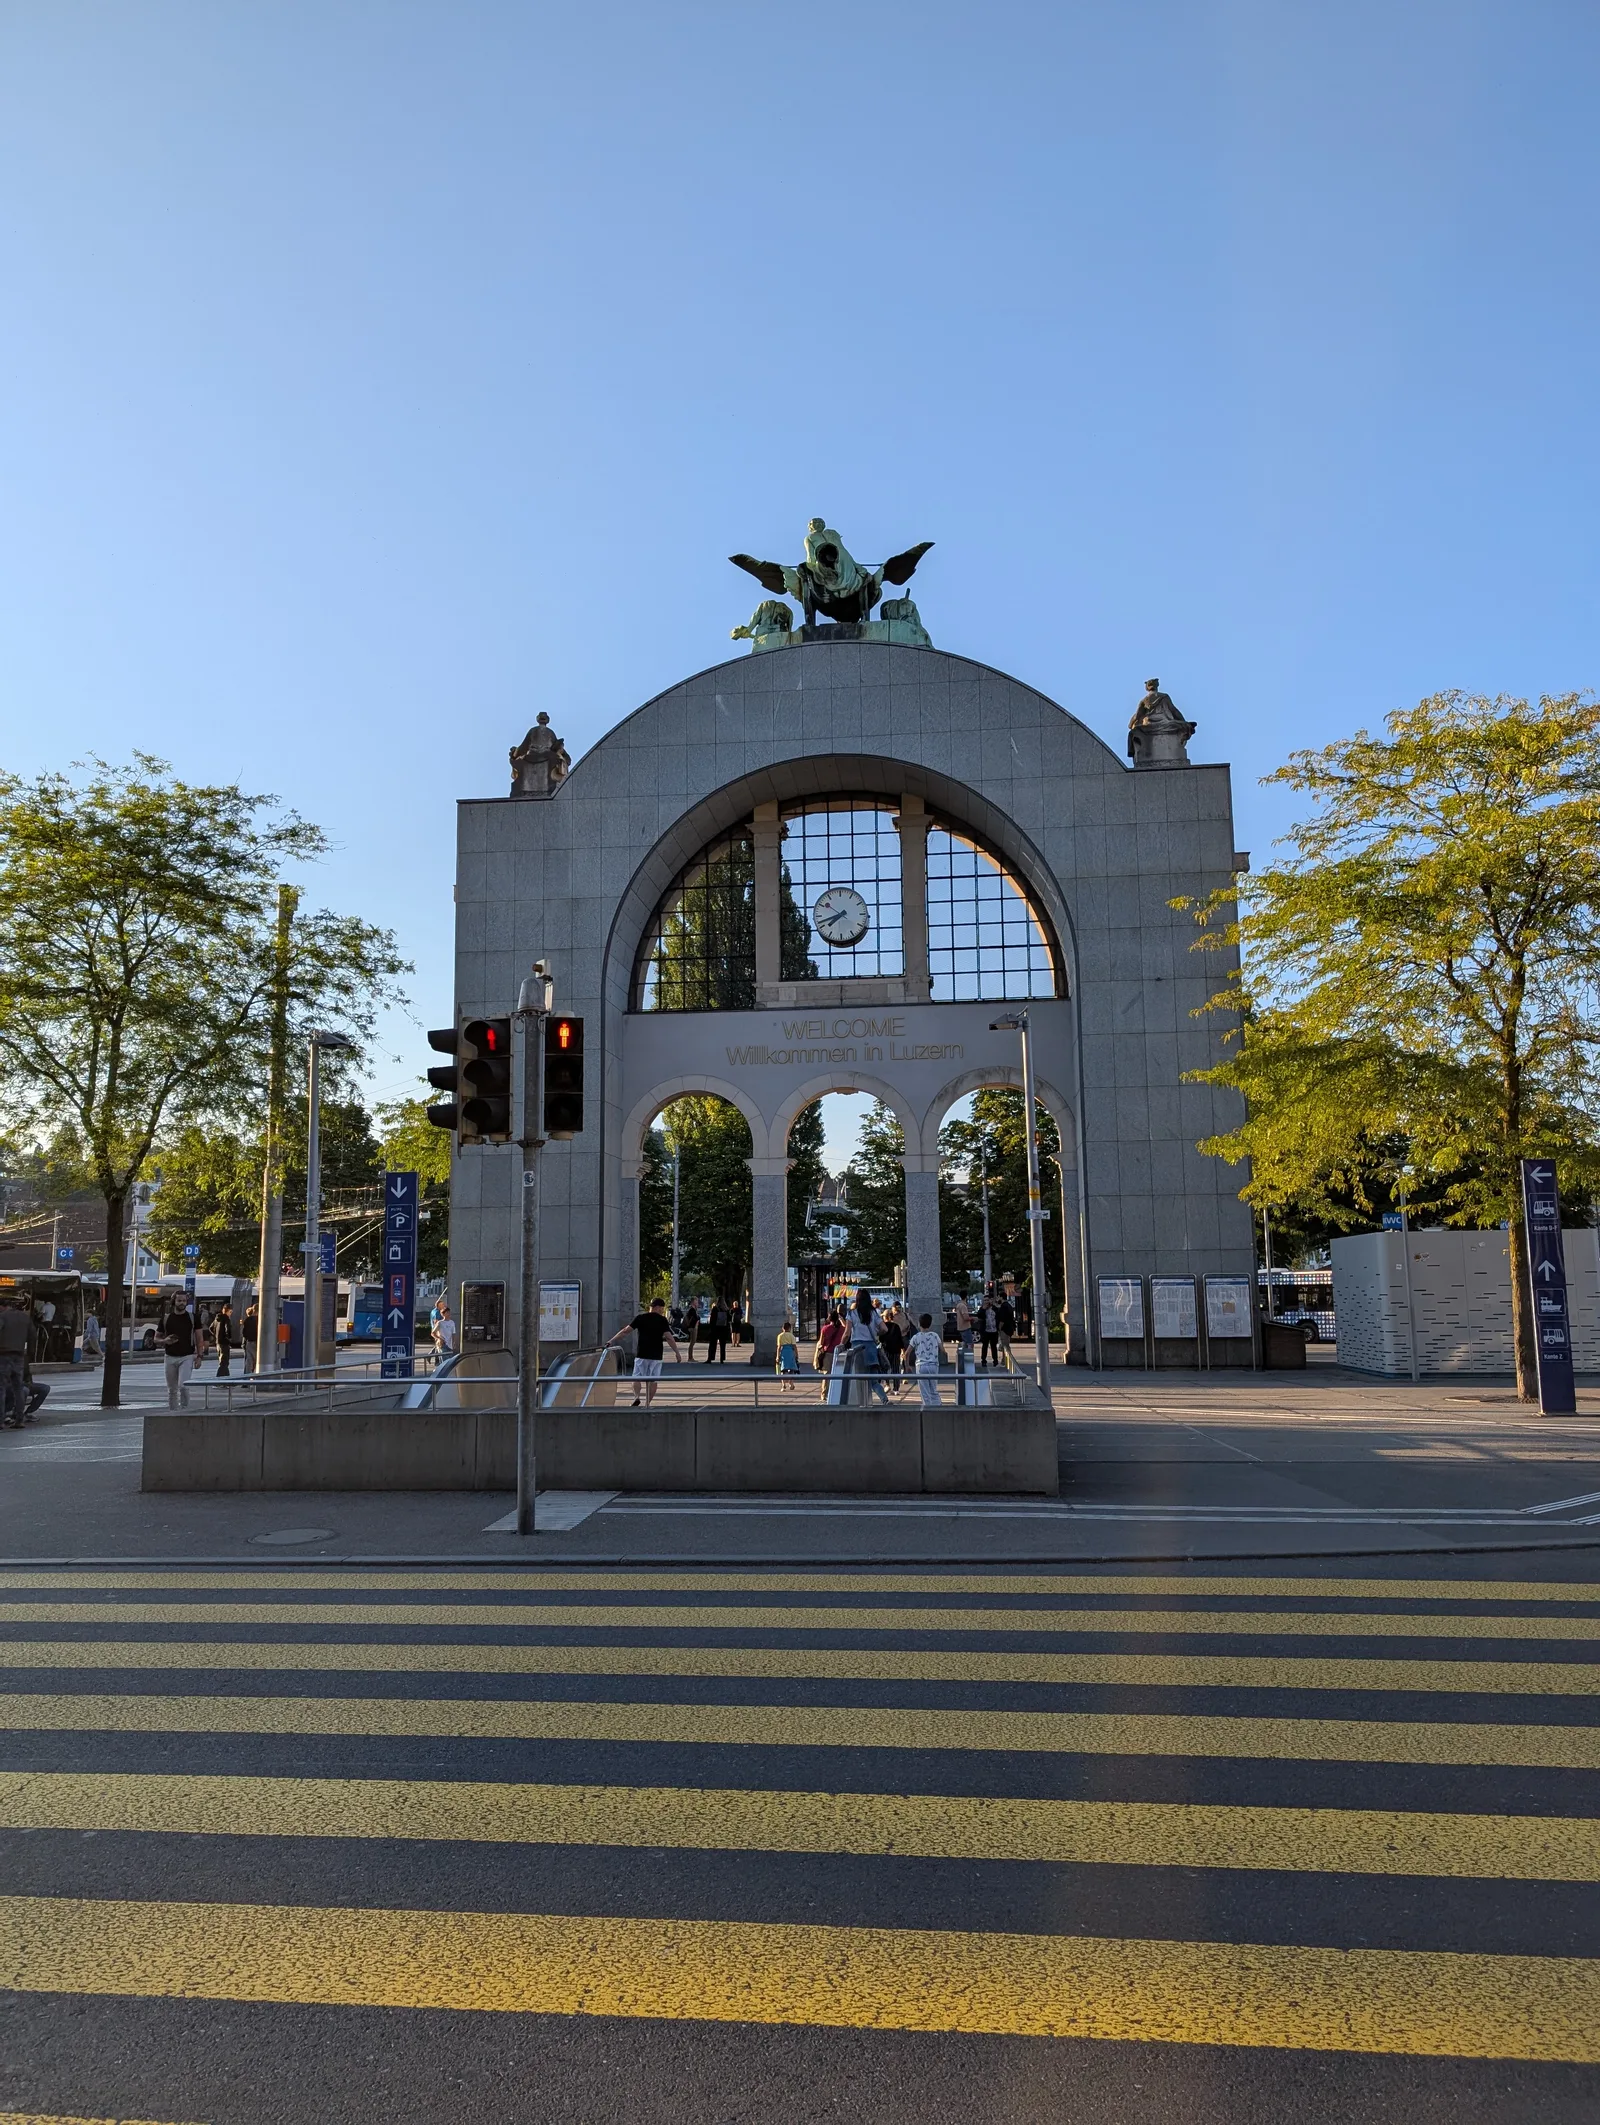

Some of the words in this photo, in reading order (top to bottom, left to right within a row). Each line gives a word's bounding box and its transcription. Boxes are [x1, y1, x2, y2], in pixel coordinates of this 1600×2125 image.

[782, 1017, 906, 1040] WELCOME
[726, 1043, 857, 1065] Willkommen
[864, 1042, 883, 1061] in
[891, 1041, 964, 1060] Luzern
